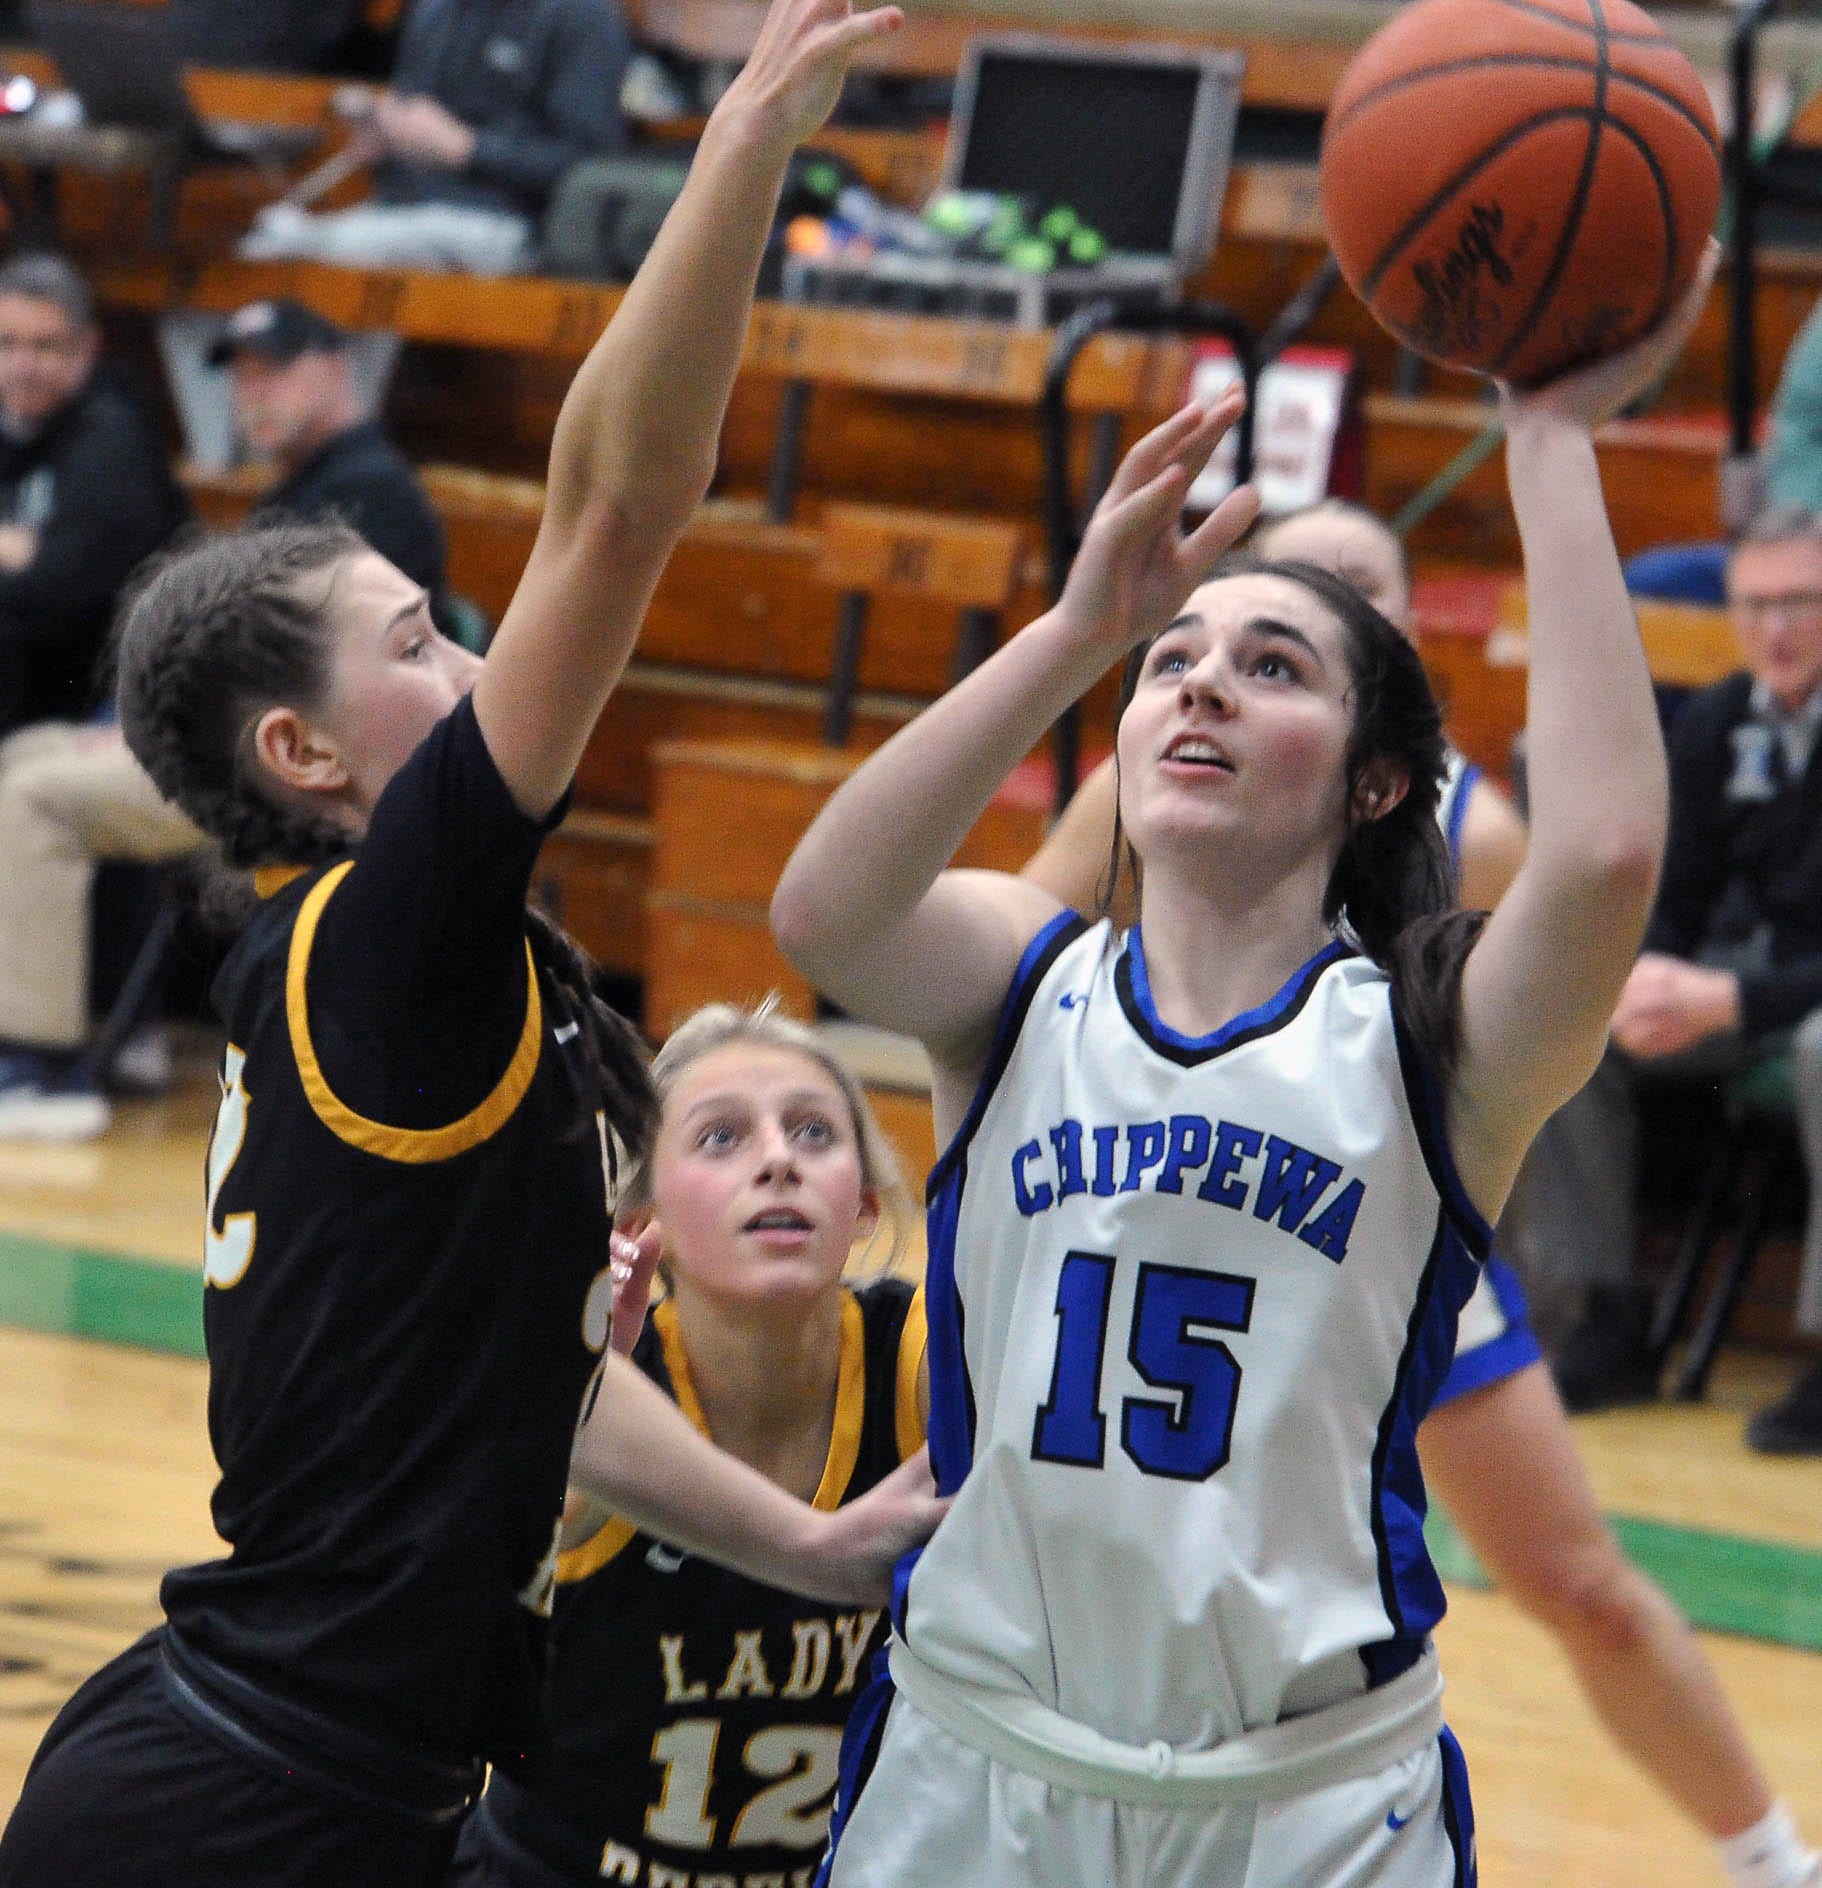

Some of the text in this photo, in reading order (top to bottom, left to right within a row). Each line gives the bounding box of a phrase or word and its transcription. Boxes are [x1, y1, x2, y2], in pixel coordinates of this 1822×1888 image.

[1011, 1114, 1366, 1265] CHIPPEWA
[1030, 1249, 1257, 1483] 15
[658, 1606, 882, 1706] LADY
[642, 1716, 846, 1852] 12
